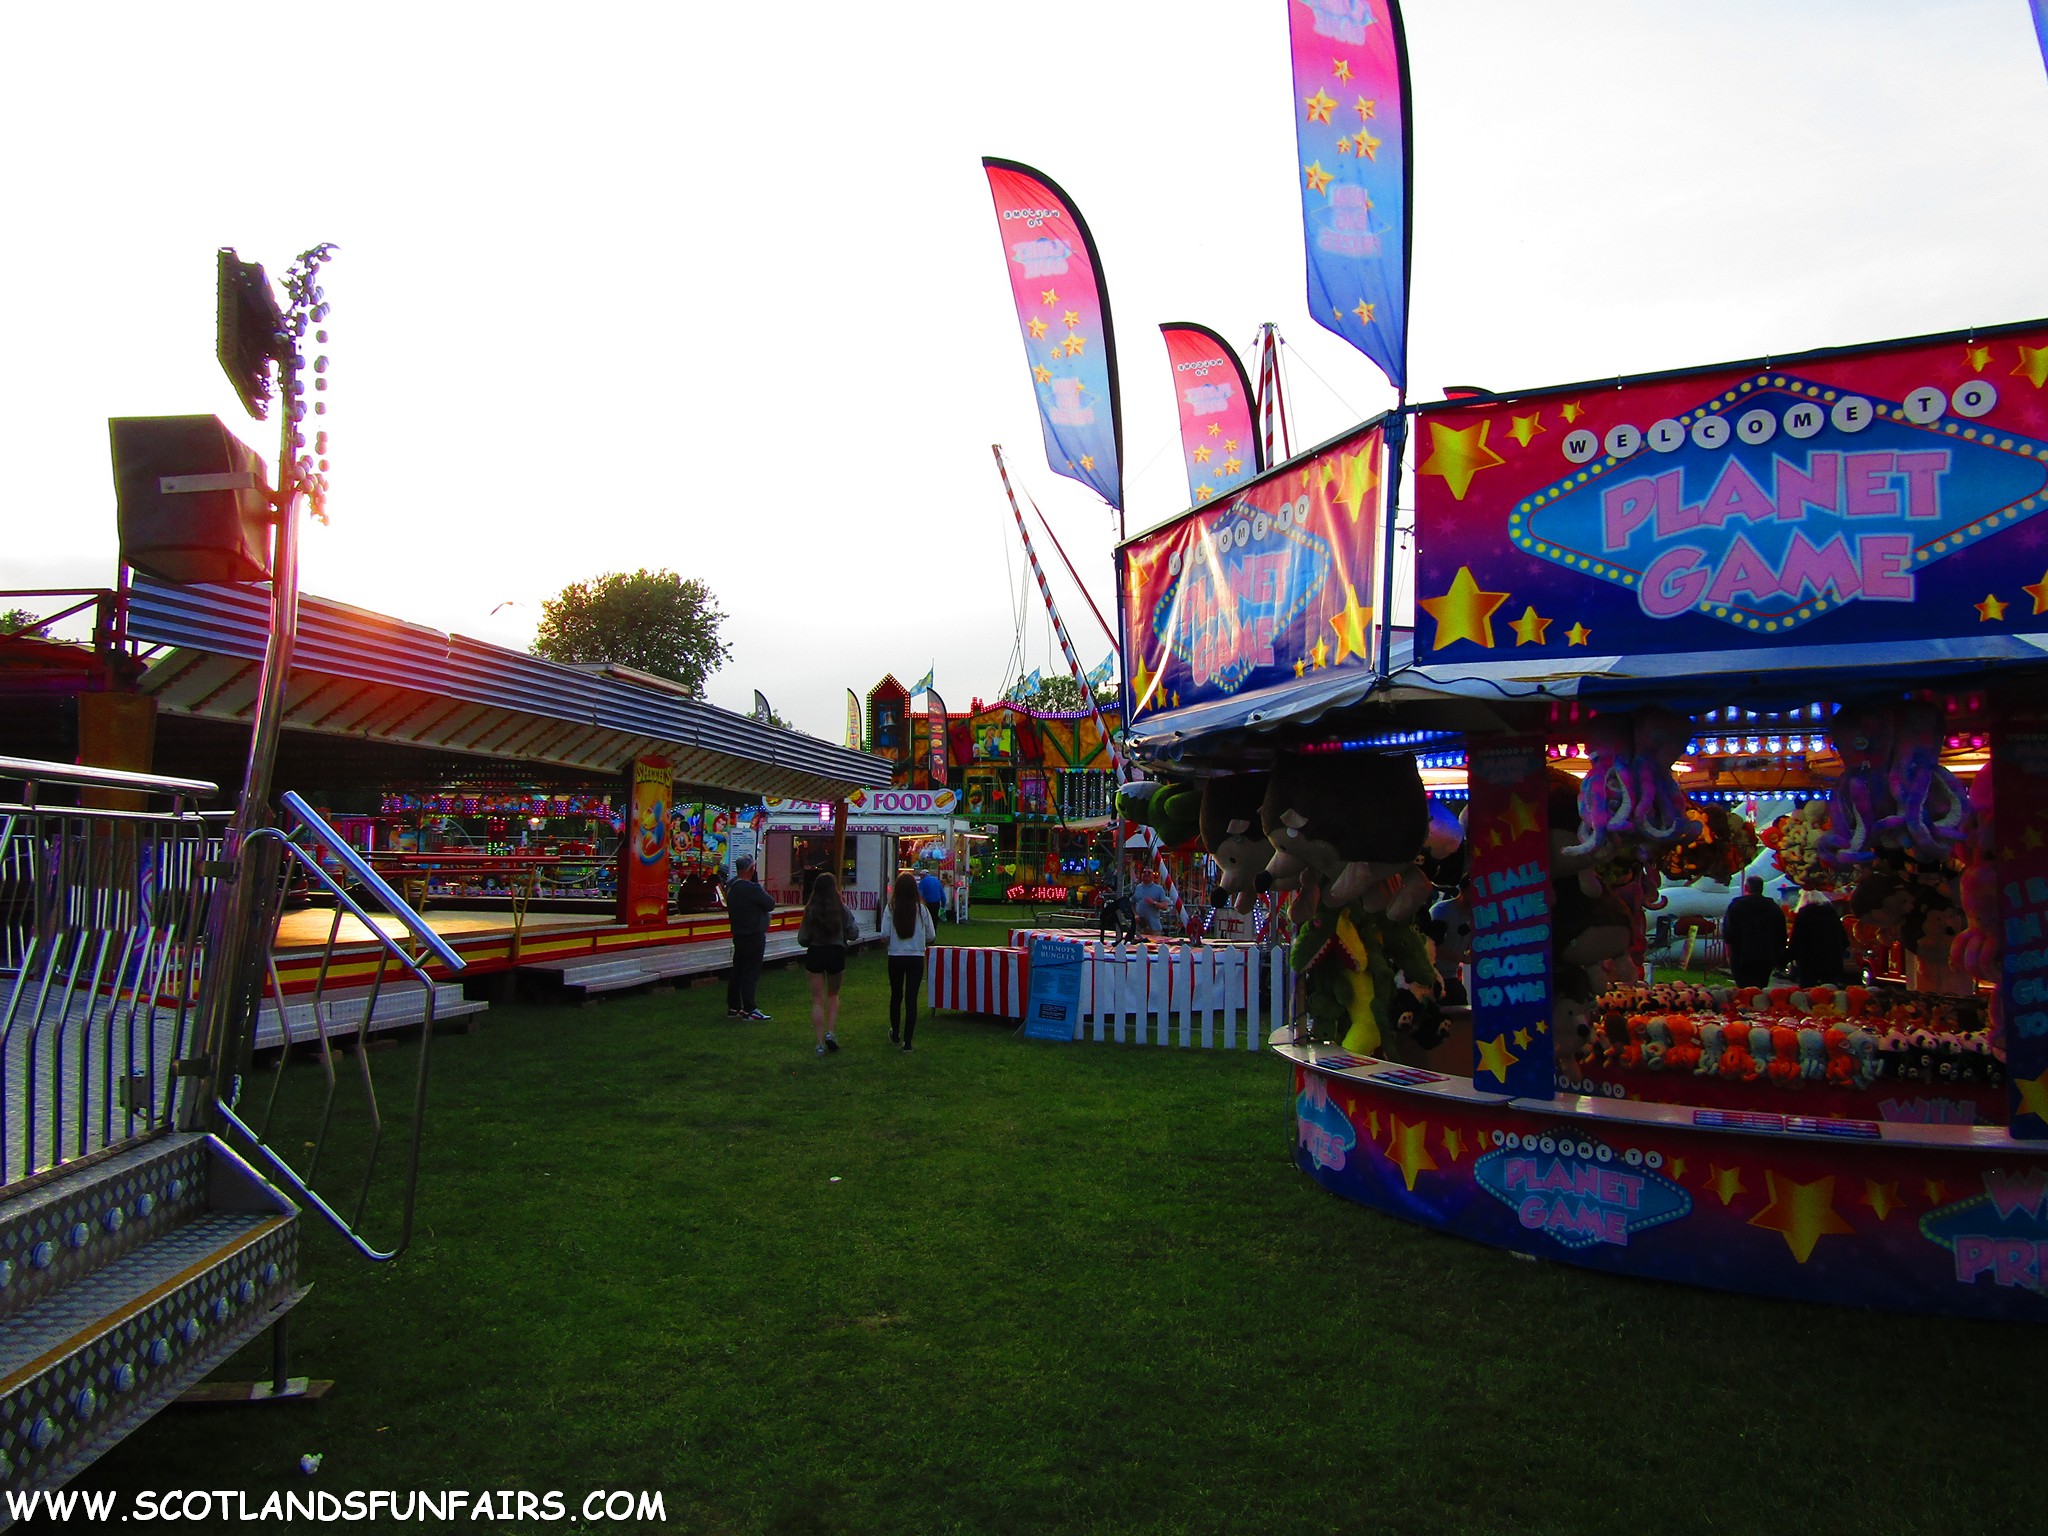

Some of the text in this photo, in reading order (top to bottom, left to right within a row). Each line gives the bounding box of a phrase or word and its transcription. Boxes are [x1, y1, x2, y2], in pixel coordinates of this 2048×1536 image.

[1566, 385, 1986, 456] WELCOME TO
[1602, 450, 1950, 552] PLANET
[1168, 499, 1306, 574] LOME TO
[1638, 530, 1915, 618] GAME
[1193, 616, 1275, 687] GAME
[873, 793, 932, 811] FOOD
[1473, 861, 1547, 898] 1 BALL
[1472, 891, 1548, 930] IN THE
[1041, 945, 1076, 954] WILMOTS
[1041, 951, 1075, 960] BUNGEES
[1477, 952, 1546, 980] GLOBE
[1477, 980, 1546, 1008] TO WIN
[1879, 1096, 1977, 1125] WIN
[1493, 1131, 1659, 1165] WELCOME TO
[1503, 1157, 1645, 1210] PLANET
[1518, 1195, 1628, 1246] GAME
